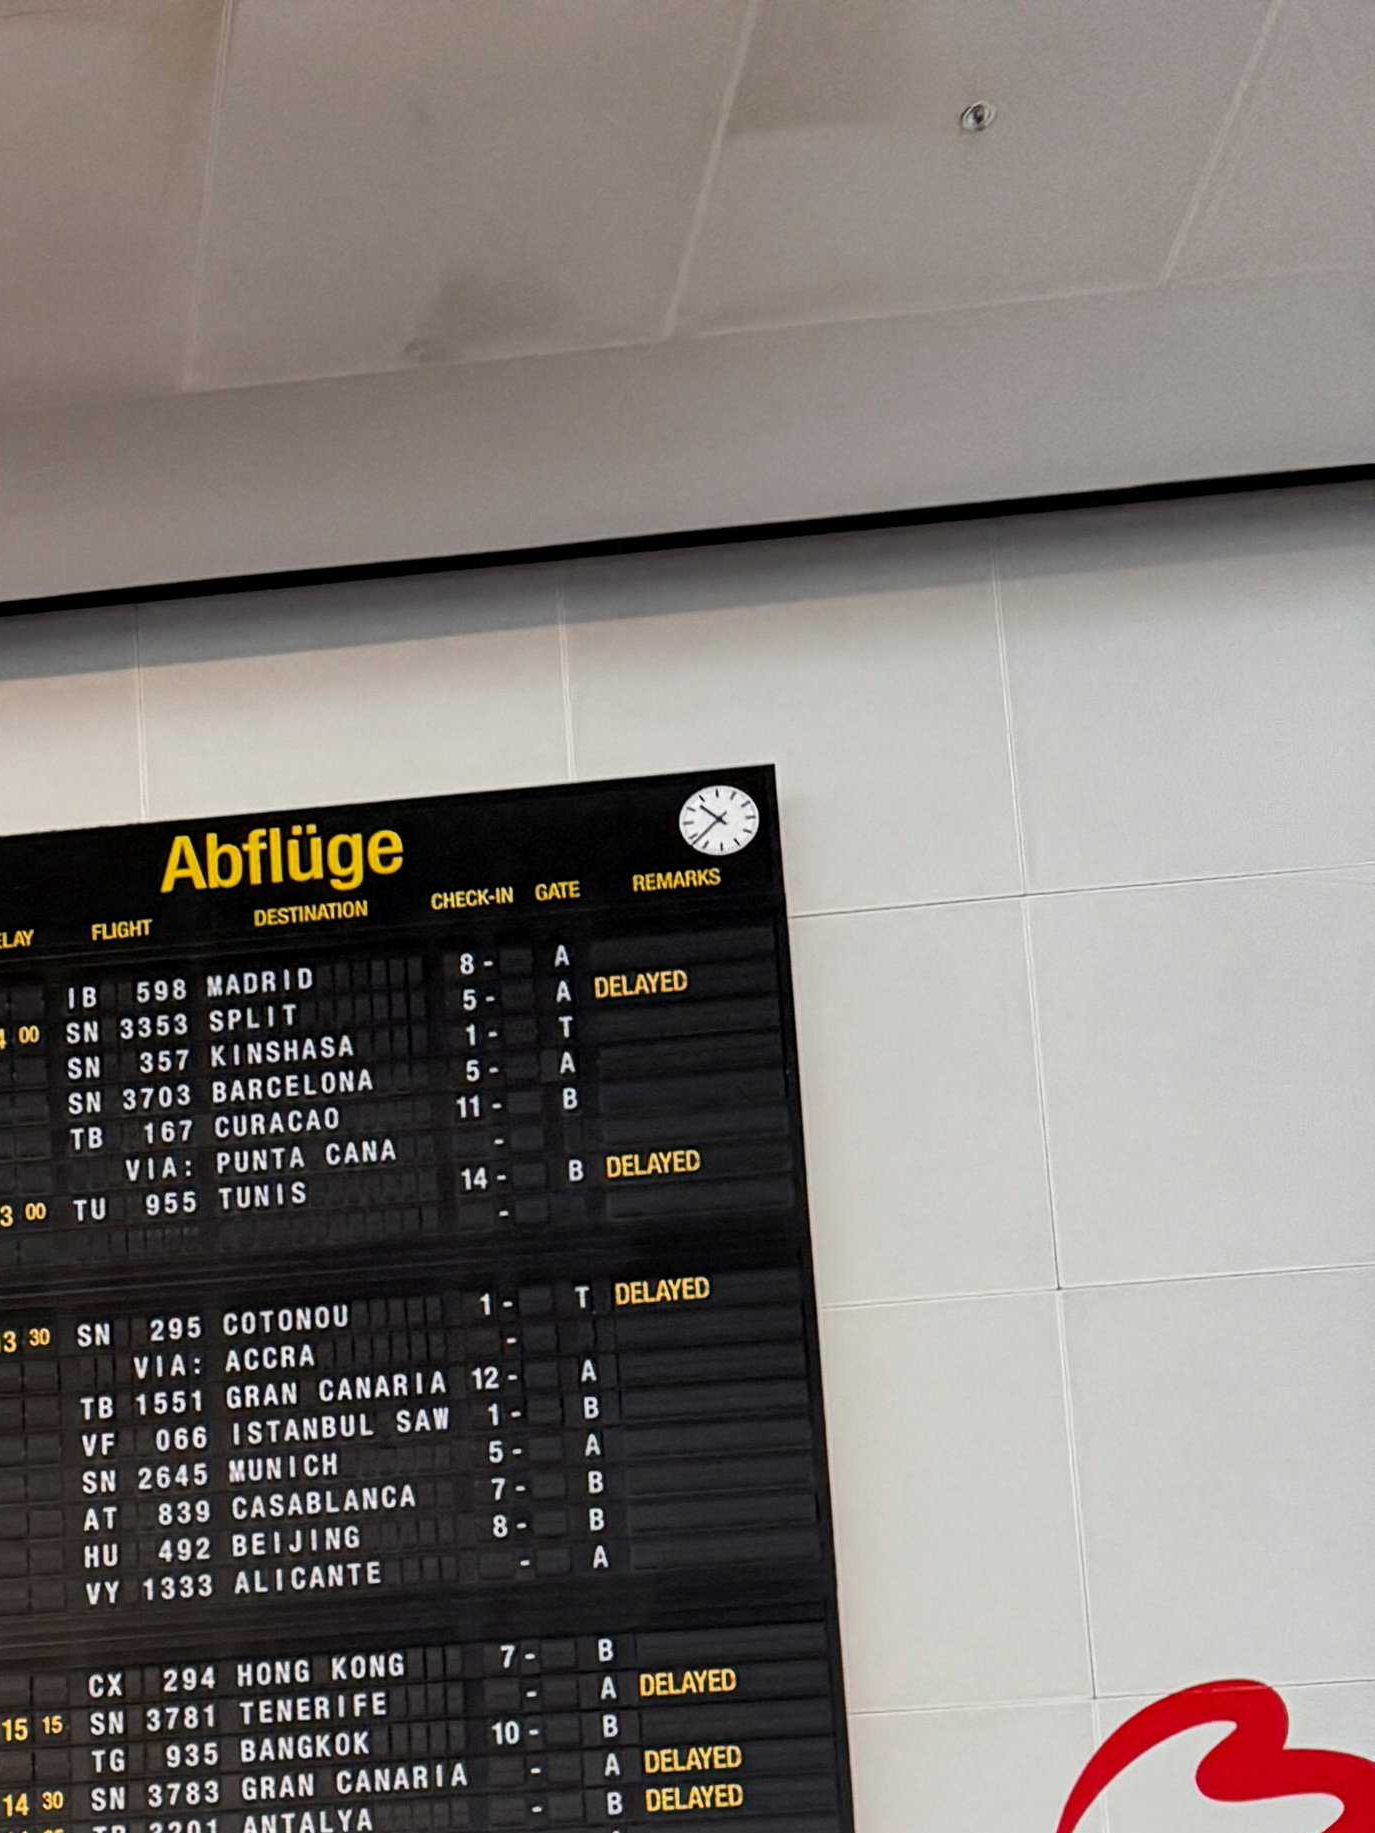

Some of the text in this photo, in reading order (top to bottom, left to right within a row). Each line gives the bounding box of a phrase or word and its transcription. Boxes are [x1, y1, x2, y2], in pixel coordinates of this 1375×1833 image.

[161, 824, 402, 892] Abflüge
[92, 920, 151, 940] FLIGHT
[255, 901, 367, 926] DESTINATION
[432, 888, 513, 909] CHECK-IN
[536, 881, 579, 900] GATE
[633, 869, 720, 891] REMARKS
[595, 970, 687, 998] DELAYED
[210, 1005, 295, 1031] SPLIT
[212, 1036, 353, 1066] KINSHASA
[216, 1108, 338, 1137] CURACAO
[217, 1140, 395, 1173] PUNTA CANA
[219, 1150, 700, 1209] TUNIS DELAYED
[224, 1277, 709, 1335] COTONOU DELAYED
[226, 1345, 314, 1371] ACCRA
[227, 1371, 445, 1408] GRAN CANARIA
[234, 1408, 448, 1444] ISTANBUL SAW
[233, 1526, 359, 1556] BEIJING
[235, 1562, 380, 1593] ALICANTE
[238, 1653, 403, 1686] HONG KONG
[240, 1669, 736, 1724] TENERIFE DELAYED
[241, 1732, 368, 1762] BANGKOK
